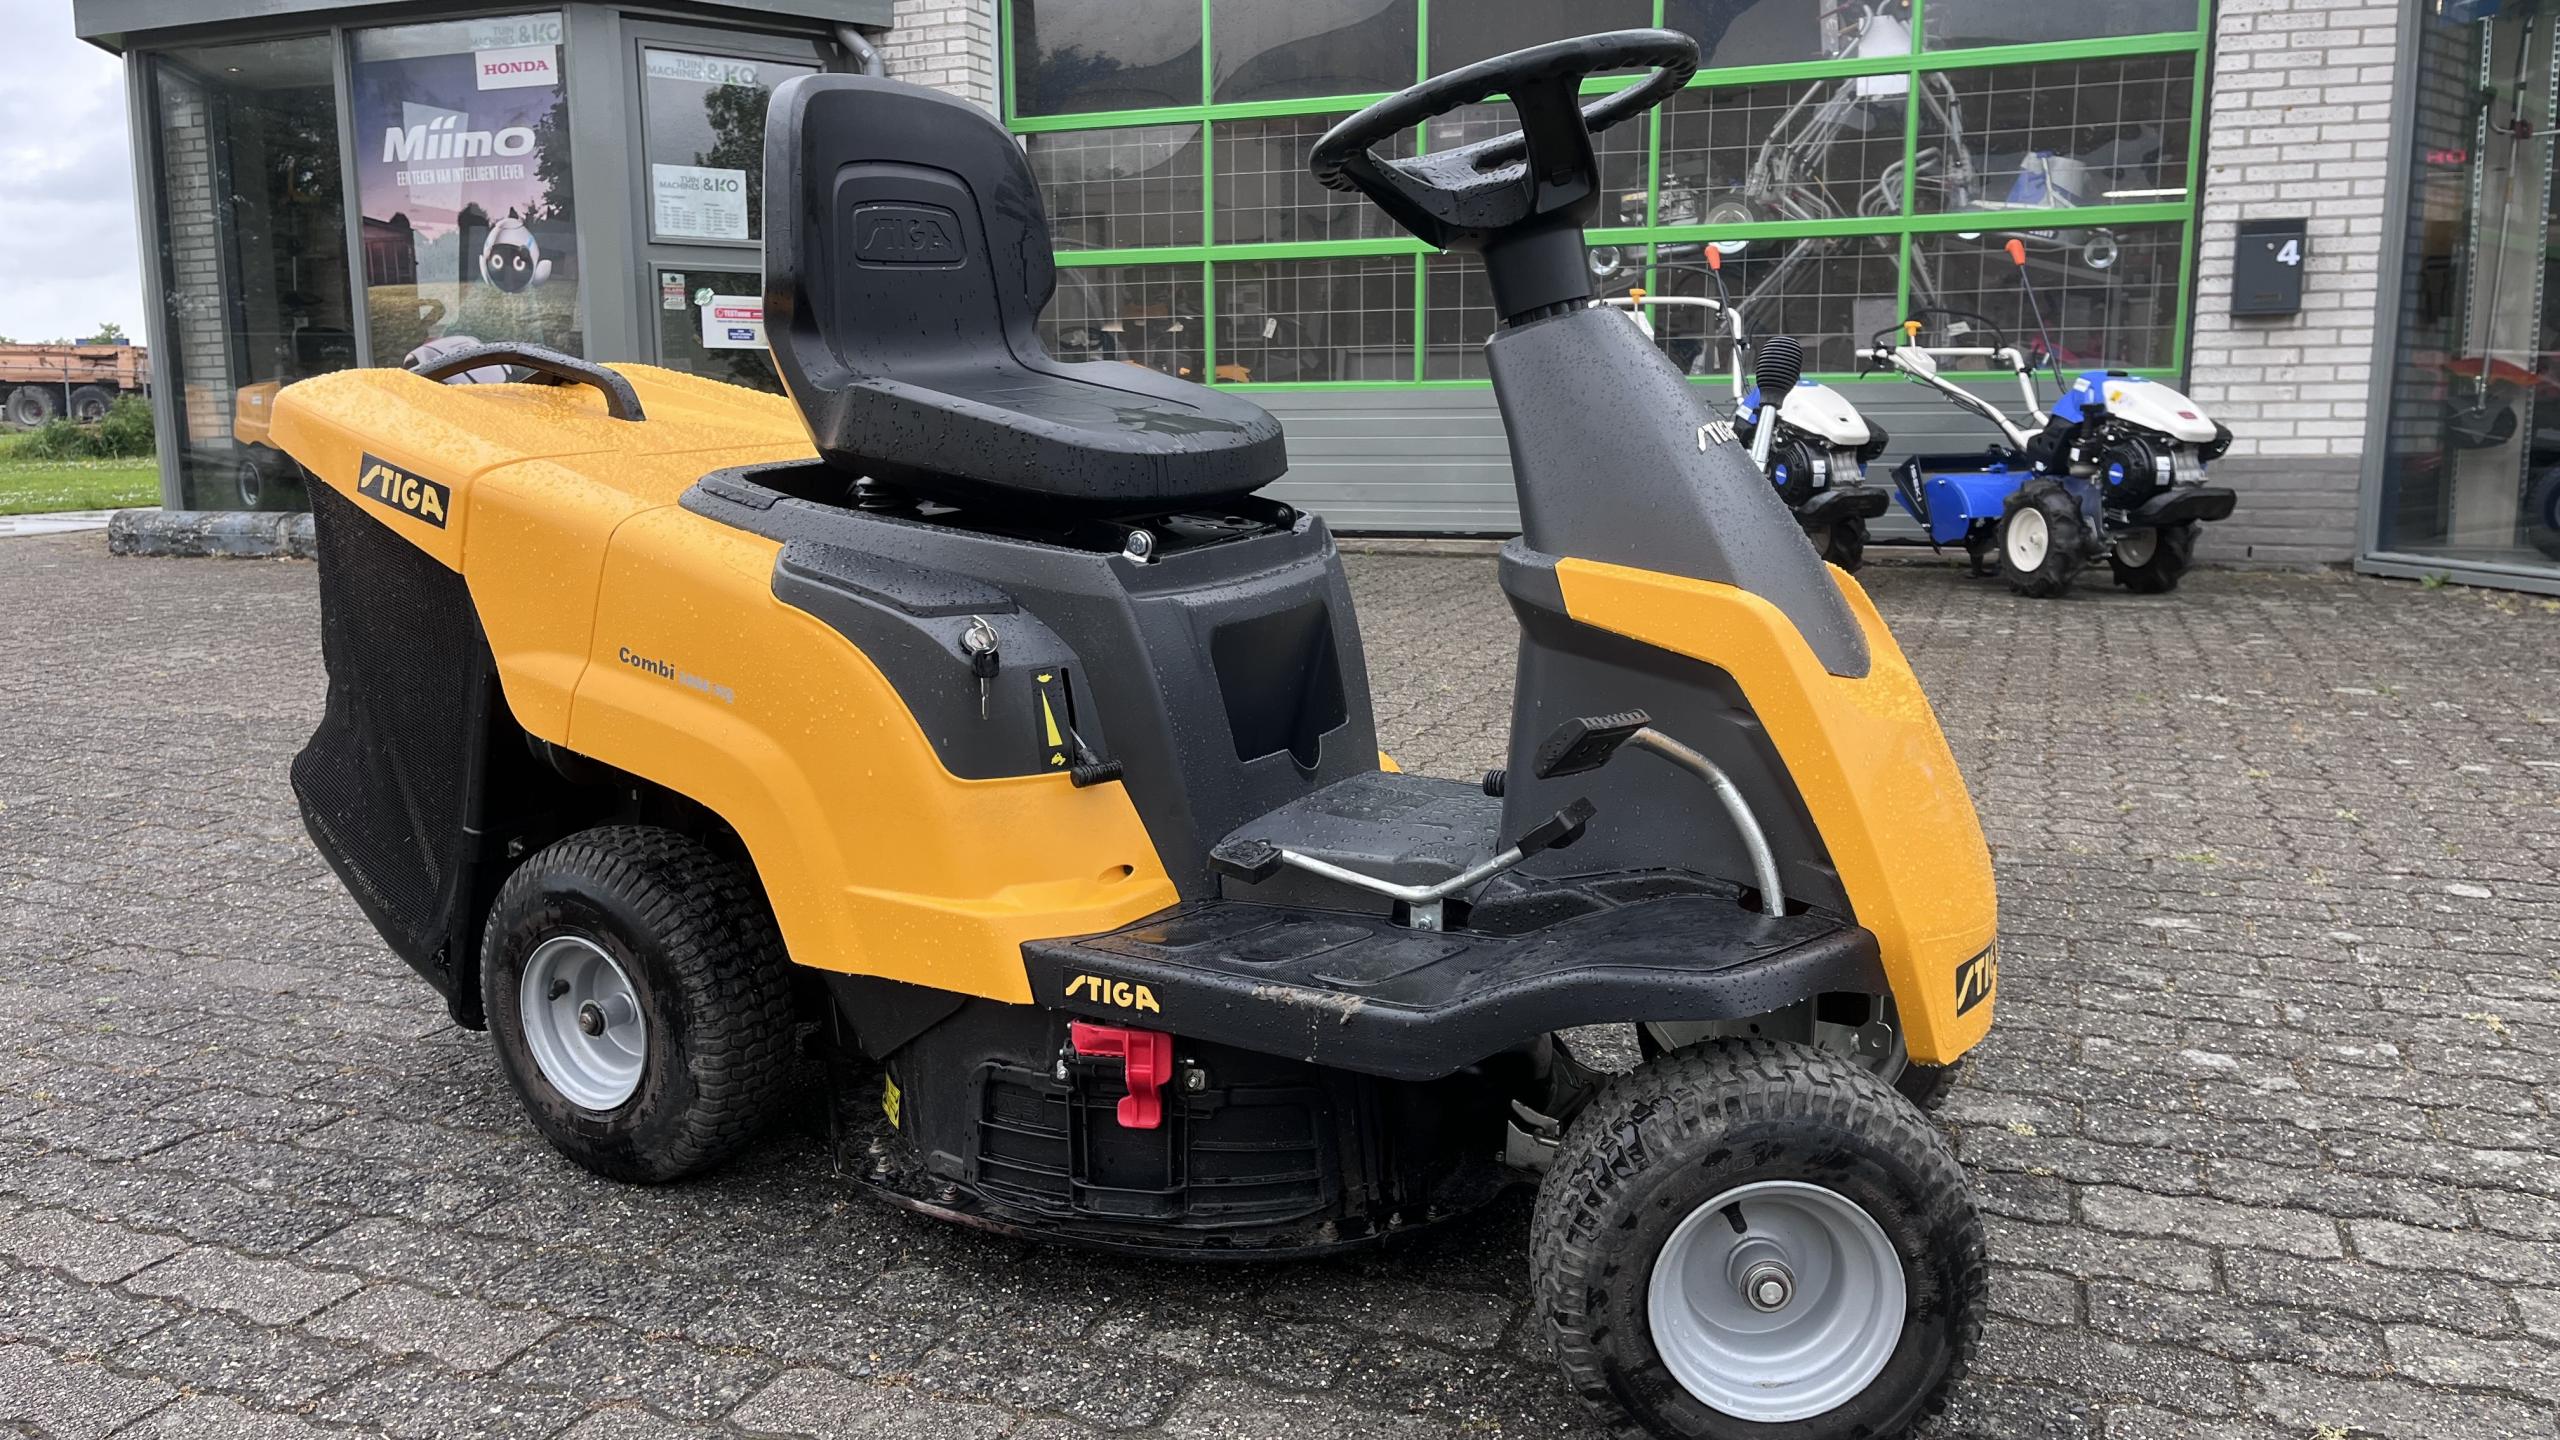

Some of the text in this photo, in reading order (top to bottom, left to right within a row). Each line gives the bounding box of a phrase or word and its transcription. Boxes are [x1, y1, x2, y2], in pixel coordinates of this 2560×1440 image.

[483, 60, 549, 75] HONDA
[382, 115, 536, 163] Miimo
[396, 164, 525, 186] EEN TEKEN VAN INTELLIGENT LEVEN
[2276, 239, 2300, 266] 4
[360, 464, 444, 522] STIGA
[619, 646, 675, 681] Combi
[1065, 975, 1160, 1014] STIGA
